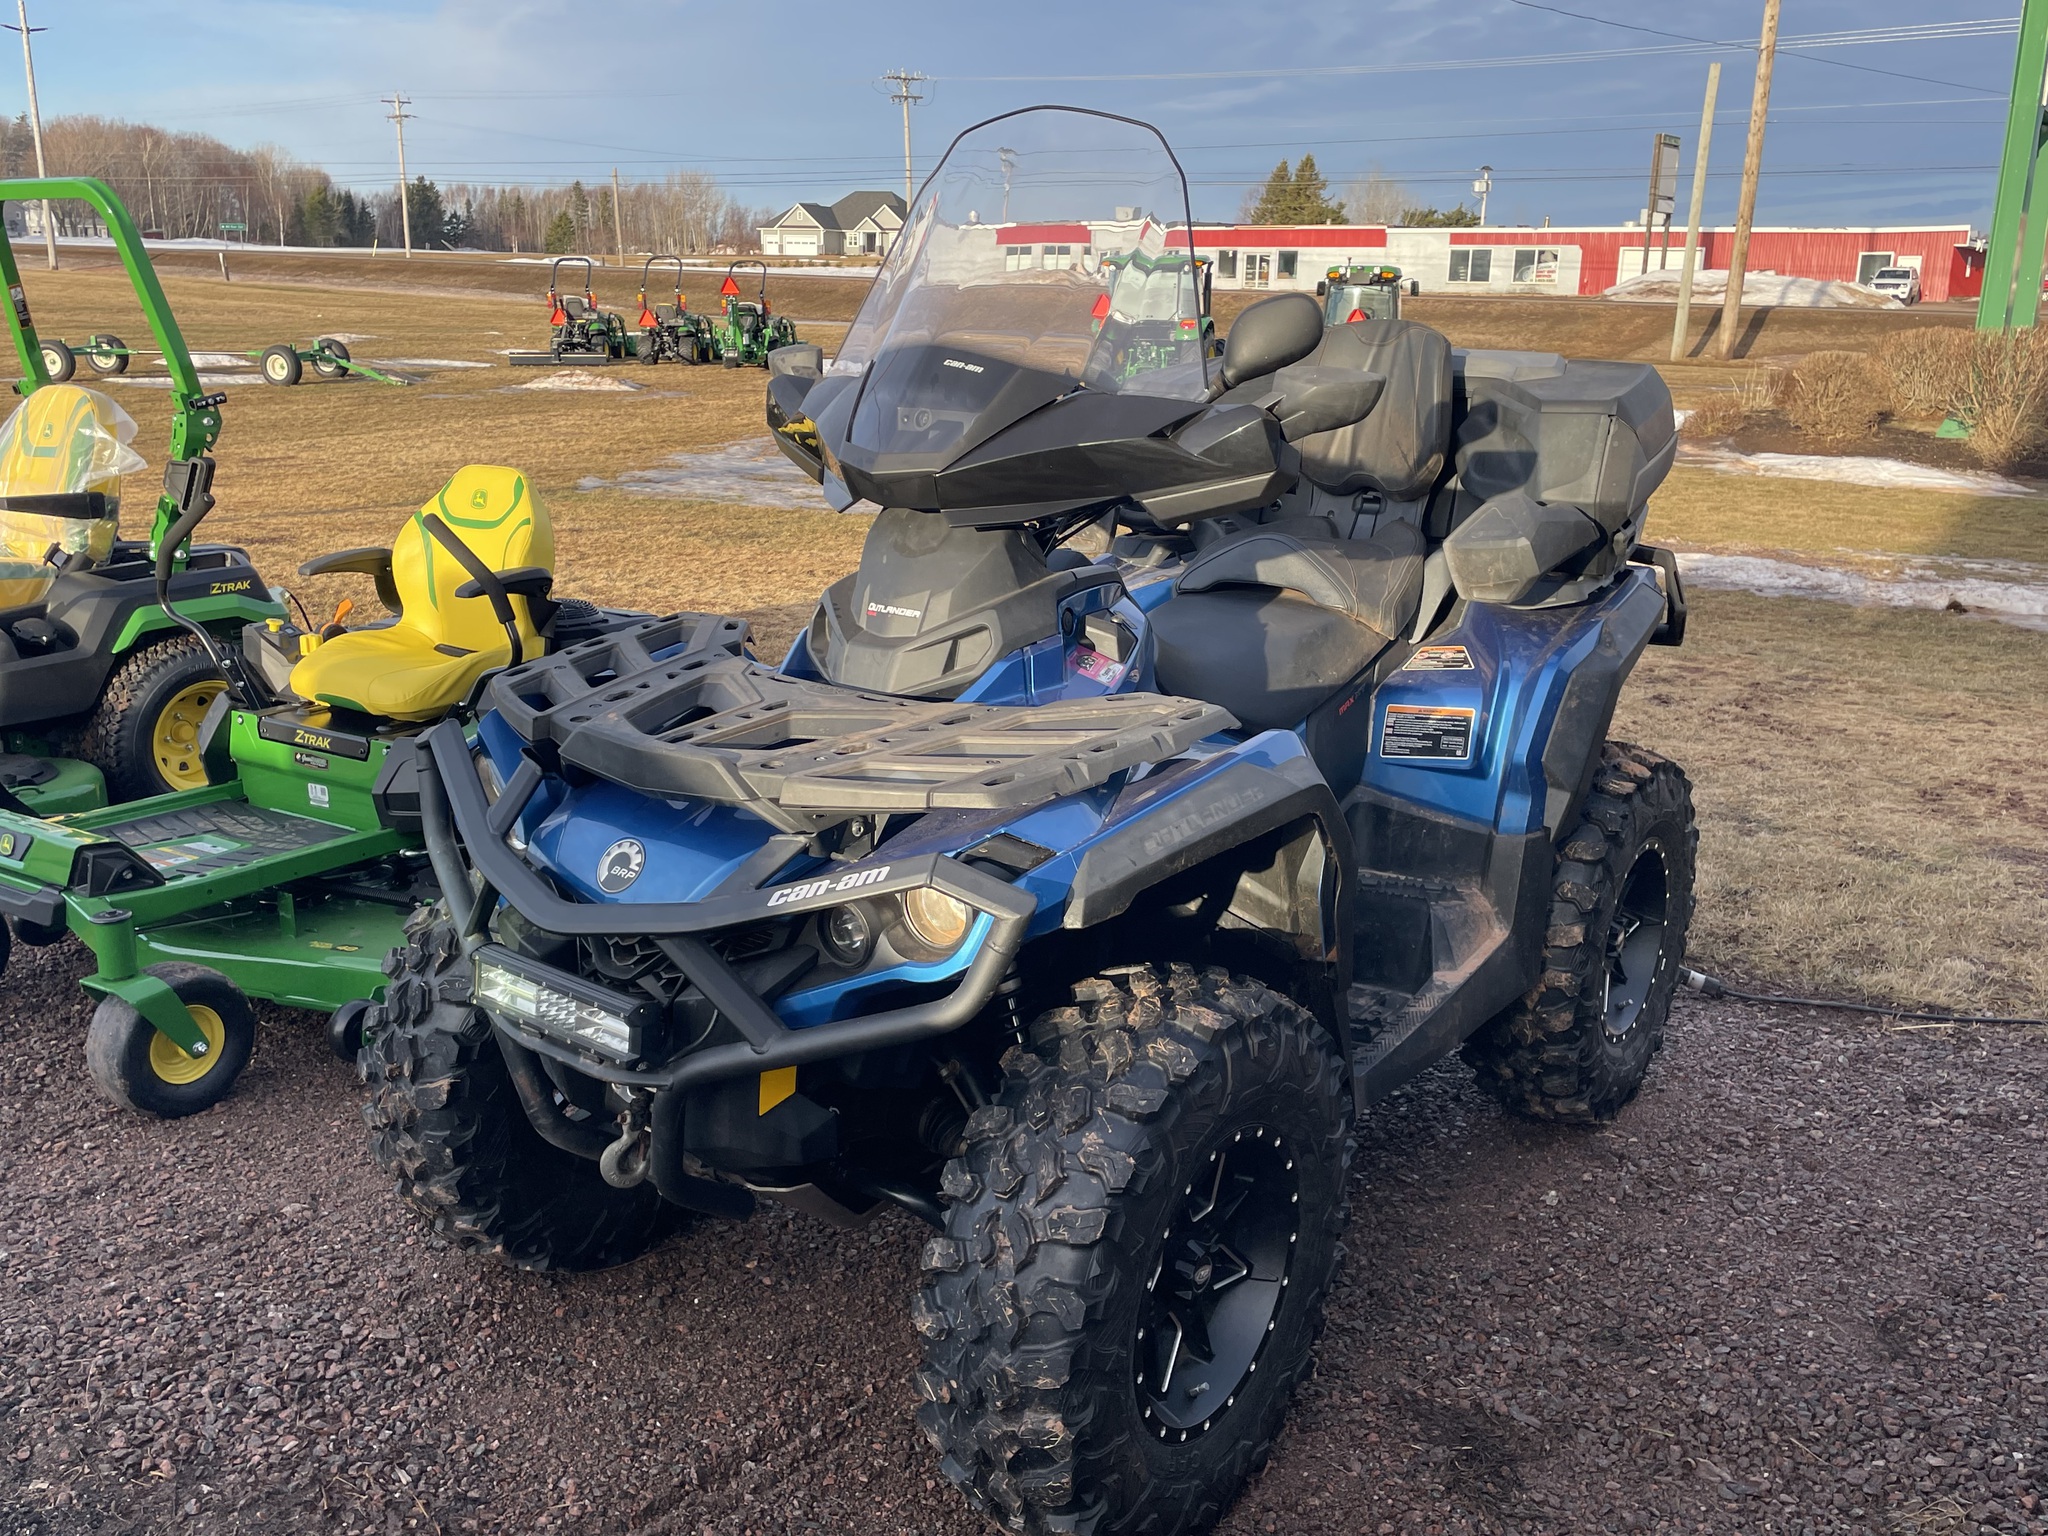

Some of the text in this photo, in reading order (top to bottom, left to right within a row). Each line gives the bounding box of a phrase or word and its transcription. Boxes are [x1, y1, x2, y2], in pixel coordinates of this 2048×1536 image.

[943, 359, 984, 373] can-am
[211, 580, 251, 594] ZTRAK
[868, 602, 921, 618] OUTLANDER
[294, 729, 331, 749] ZTRAK
[610, 866, 636, 879] BRP
[767, 866, 891, 907] can-am
